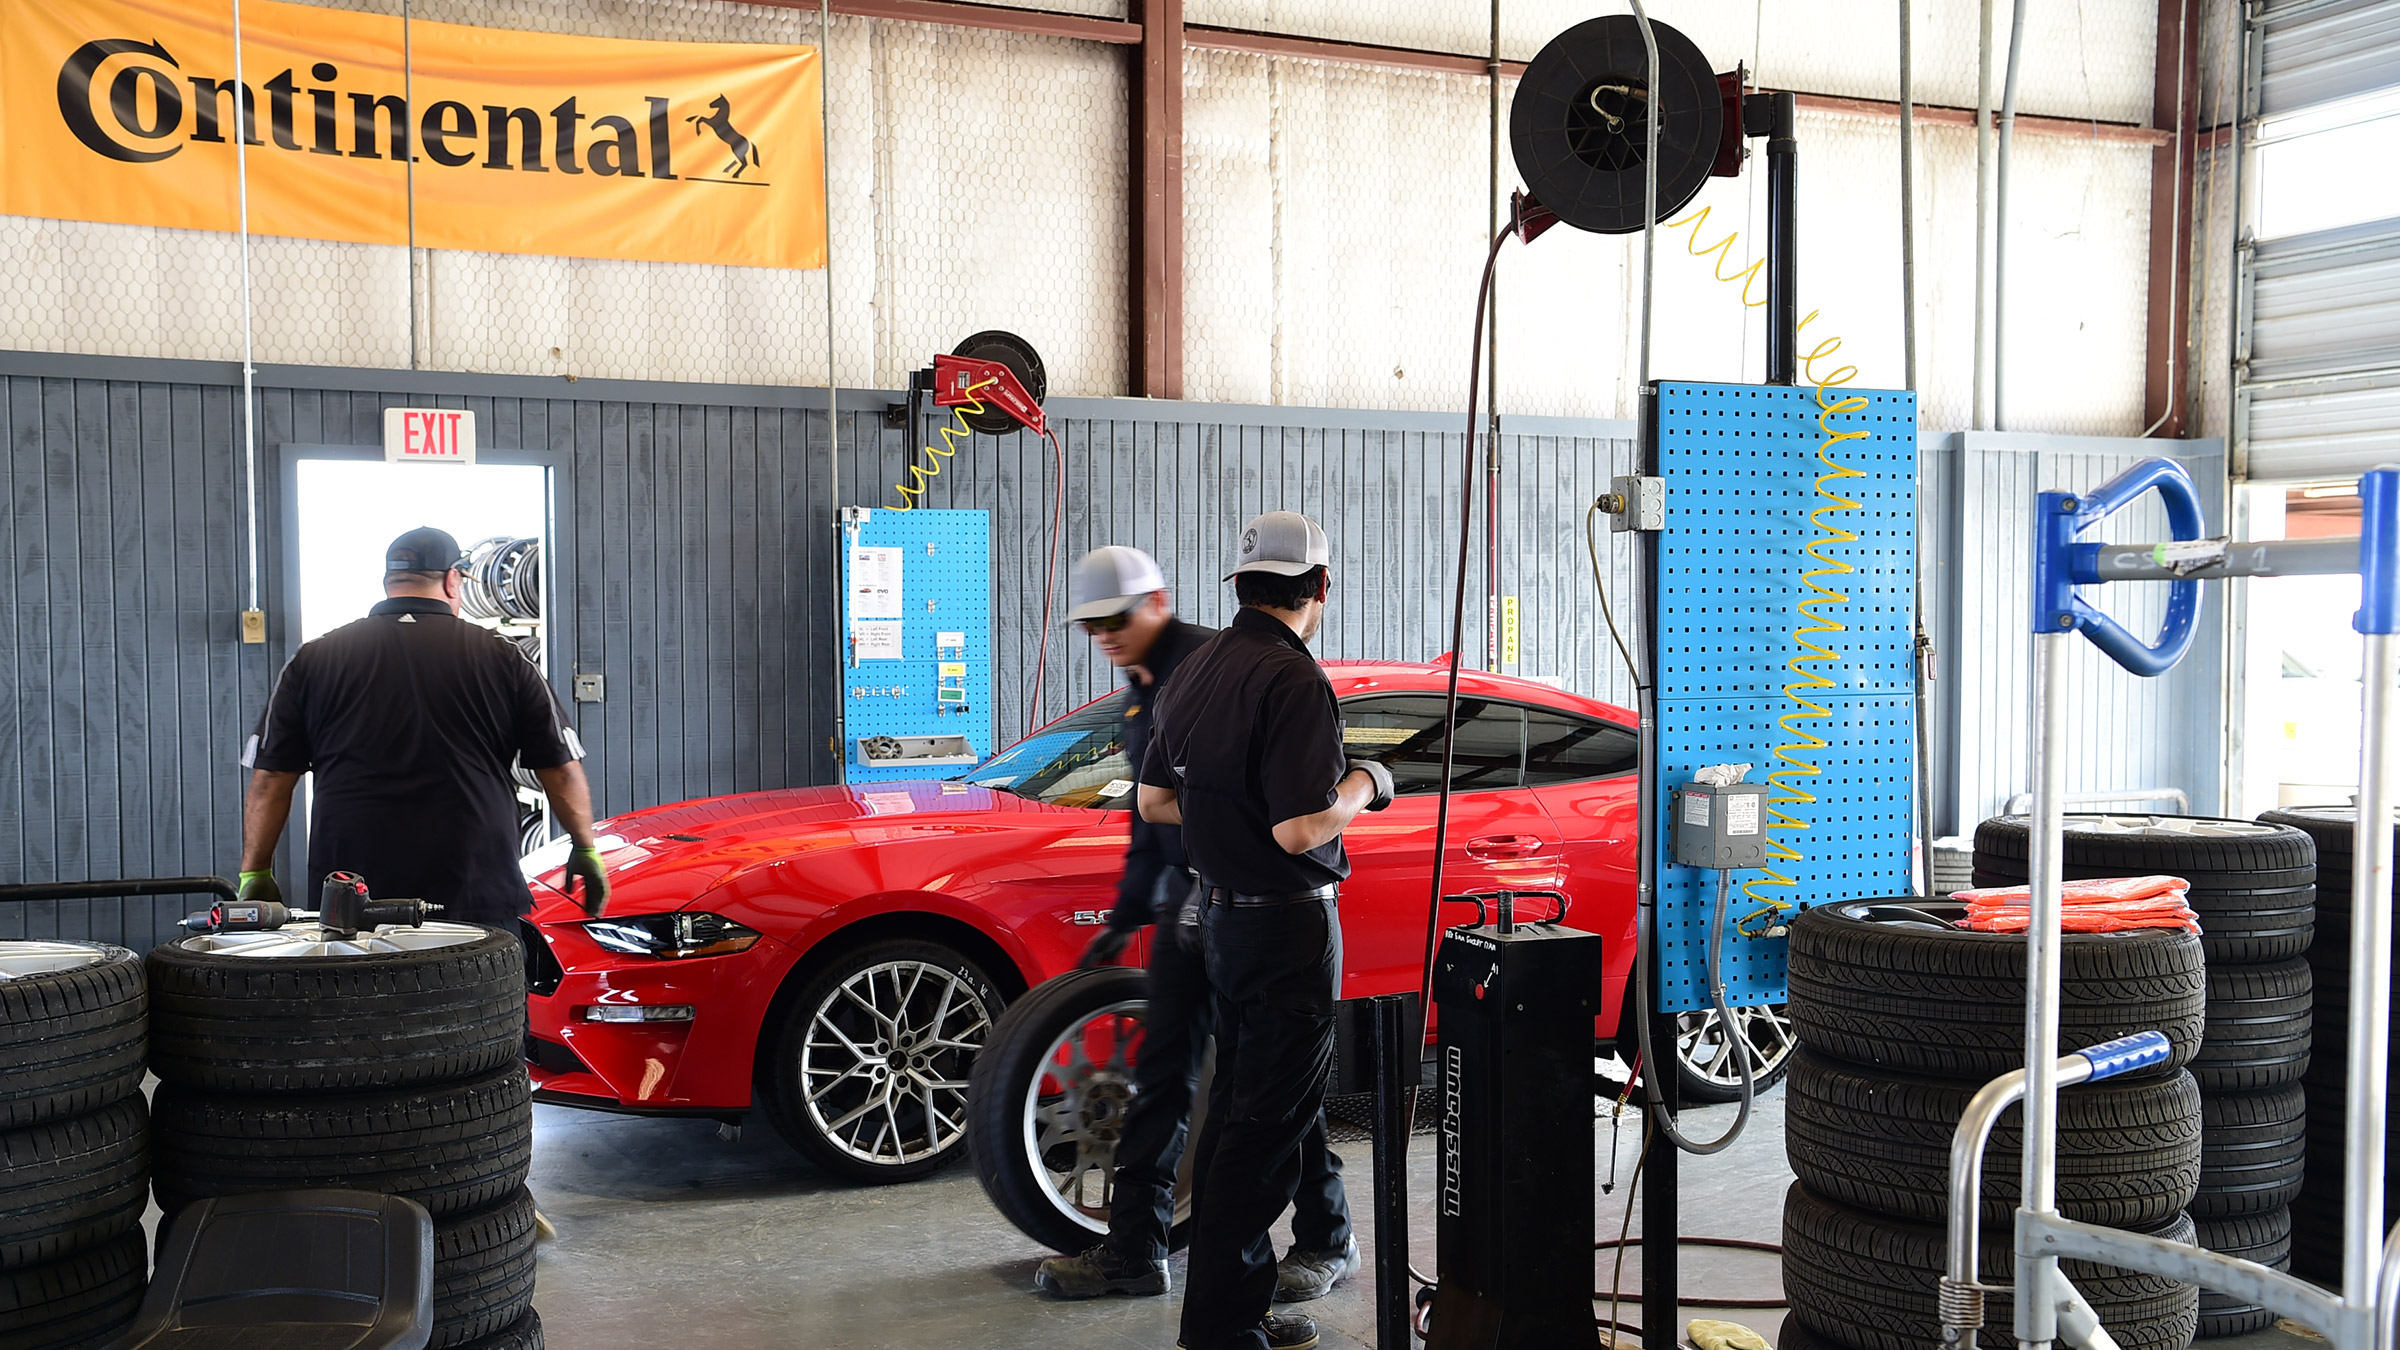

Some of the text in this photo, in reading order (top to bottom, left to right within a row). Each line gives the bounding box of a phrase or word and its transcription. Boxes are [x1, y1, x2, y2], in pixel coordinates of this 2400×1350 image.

[56, 37, 678, 182] Continental
[404, 412, 461, 455] EXIT
[1443, 1045, 1461, 1216] Nussbaum
